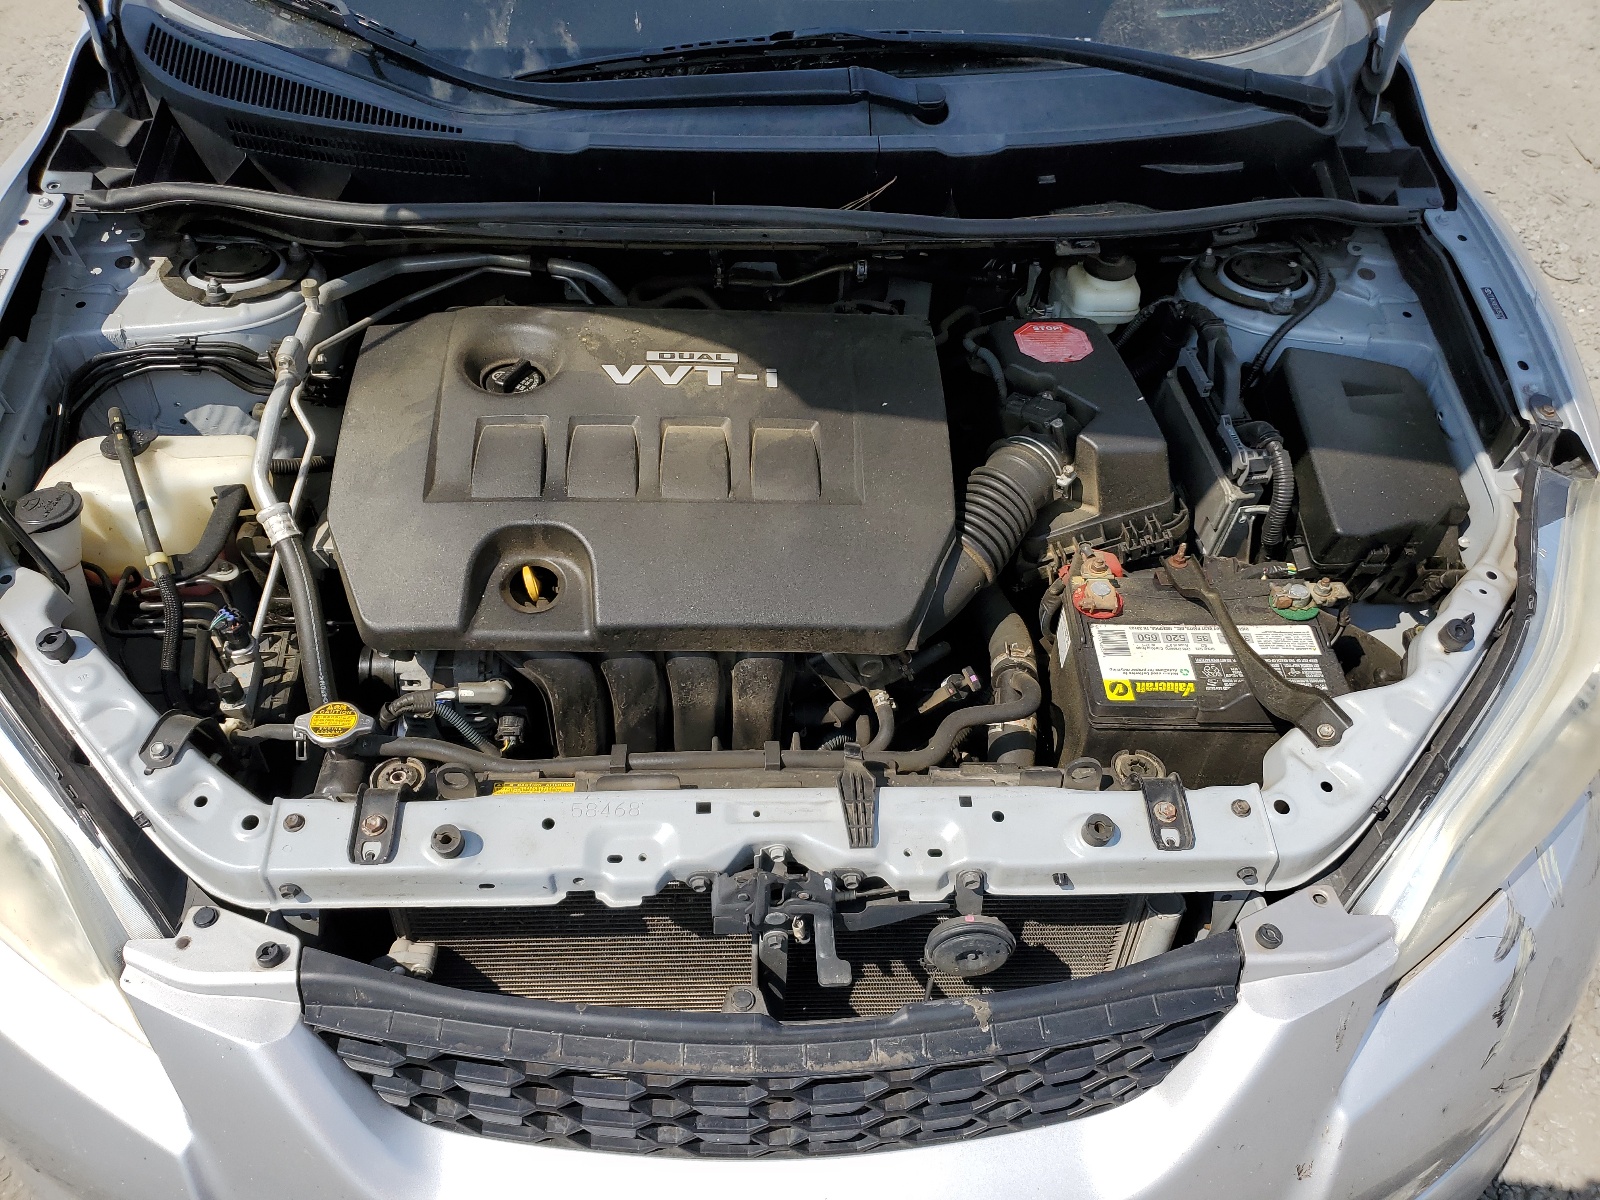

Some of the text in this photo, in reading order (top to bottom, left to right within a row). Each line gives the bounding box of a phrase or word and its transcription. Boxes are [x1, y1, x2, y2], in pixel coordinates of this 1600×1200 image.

[658, 352, 731, 361] DUAL
[601, 364, 778, 387] VVT-i
[571, 801, 641, 818] 58468
